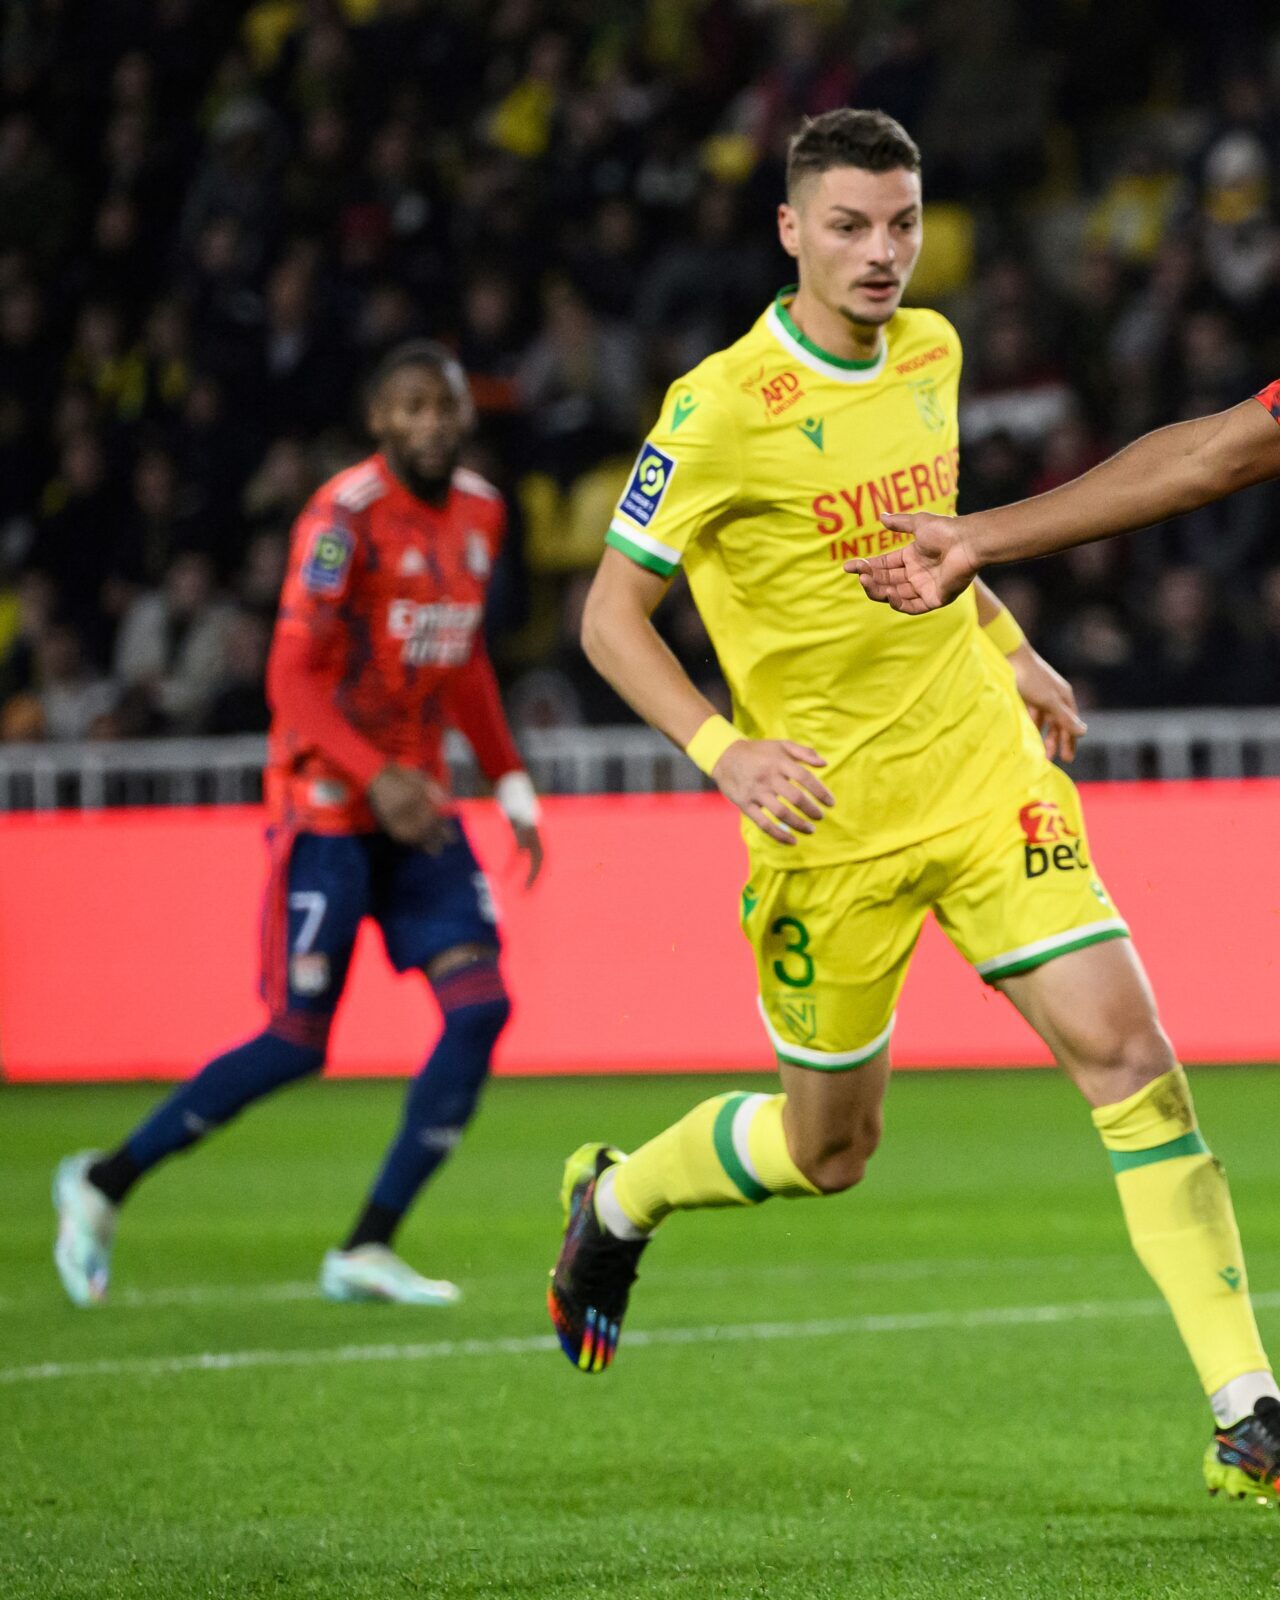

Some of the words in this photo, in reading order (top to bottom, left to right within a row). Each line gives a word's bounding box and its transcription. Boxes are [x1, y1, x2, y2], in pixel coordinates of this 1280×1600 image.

[761, 372, 799, 408] AFD
[289, 890, 327, 954] 7
[772, 916, 815, 988] 3
